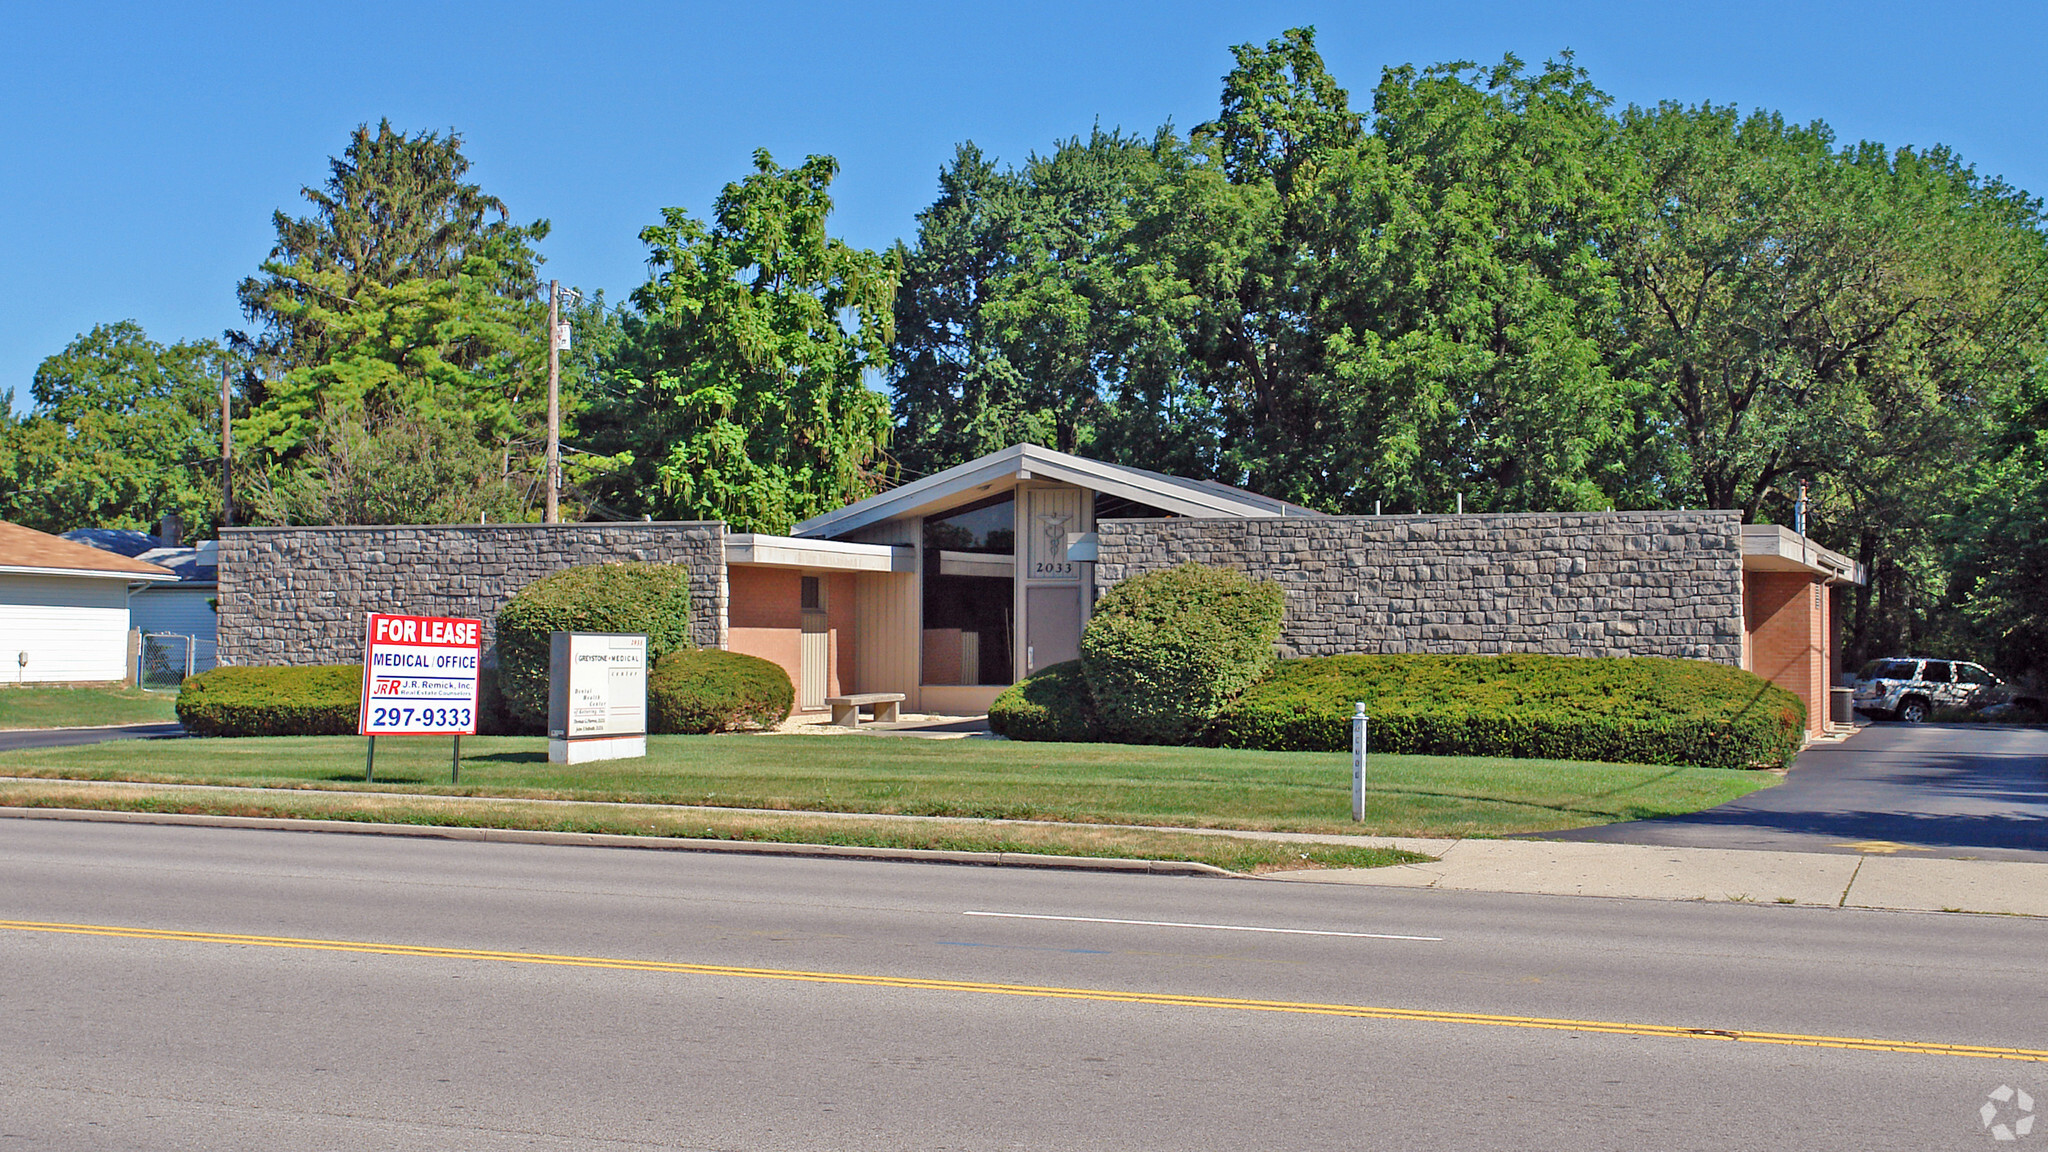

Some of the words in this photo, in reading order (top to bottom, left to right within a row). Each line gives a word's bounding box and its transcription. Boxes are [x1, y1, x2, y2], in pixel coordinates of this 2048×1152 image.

[1036, 562, 1072, 574] 2033
[376, 619, 417, 642] FOR
[421, 621, 477, 644] LEASE
[458, 682, 473, 690] Inc.
[373, 708, 471, 726] 297-9333
